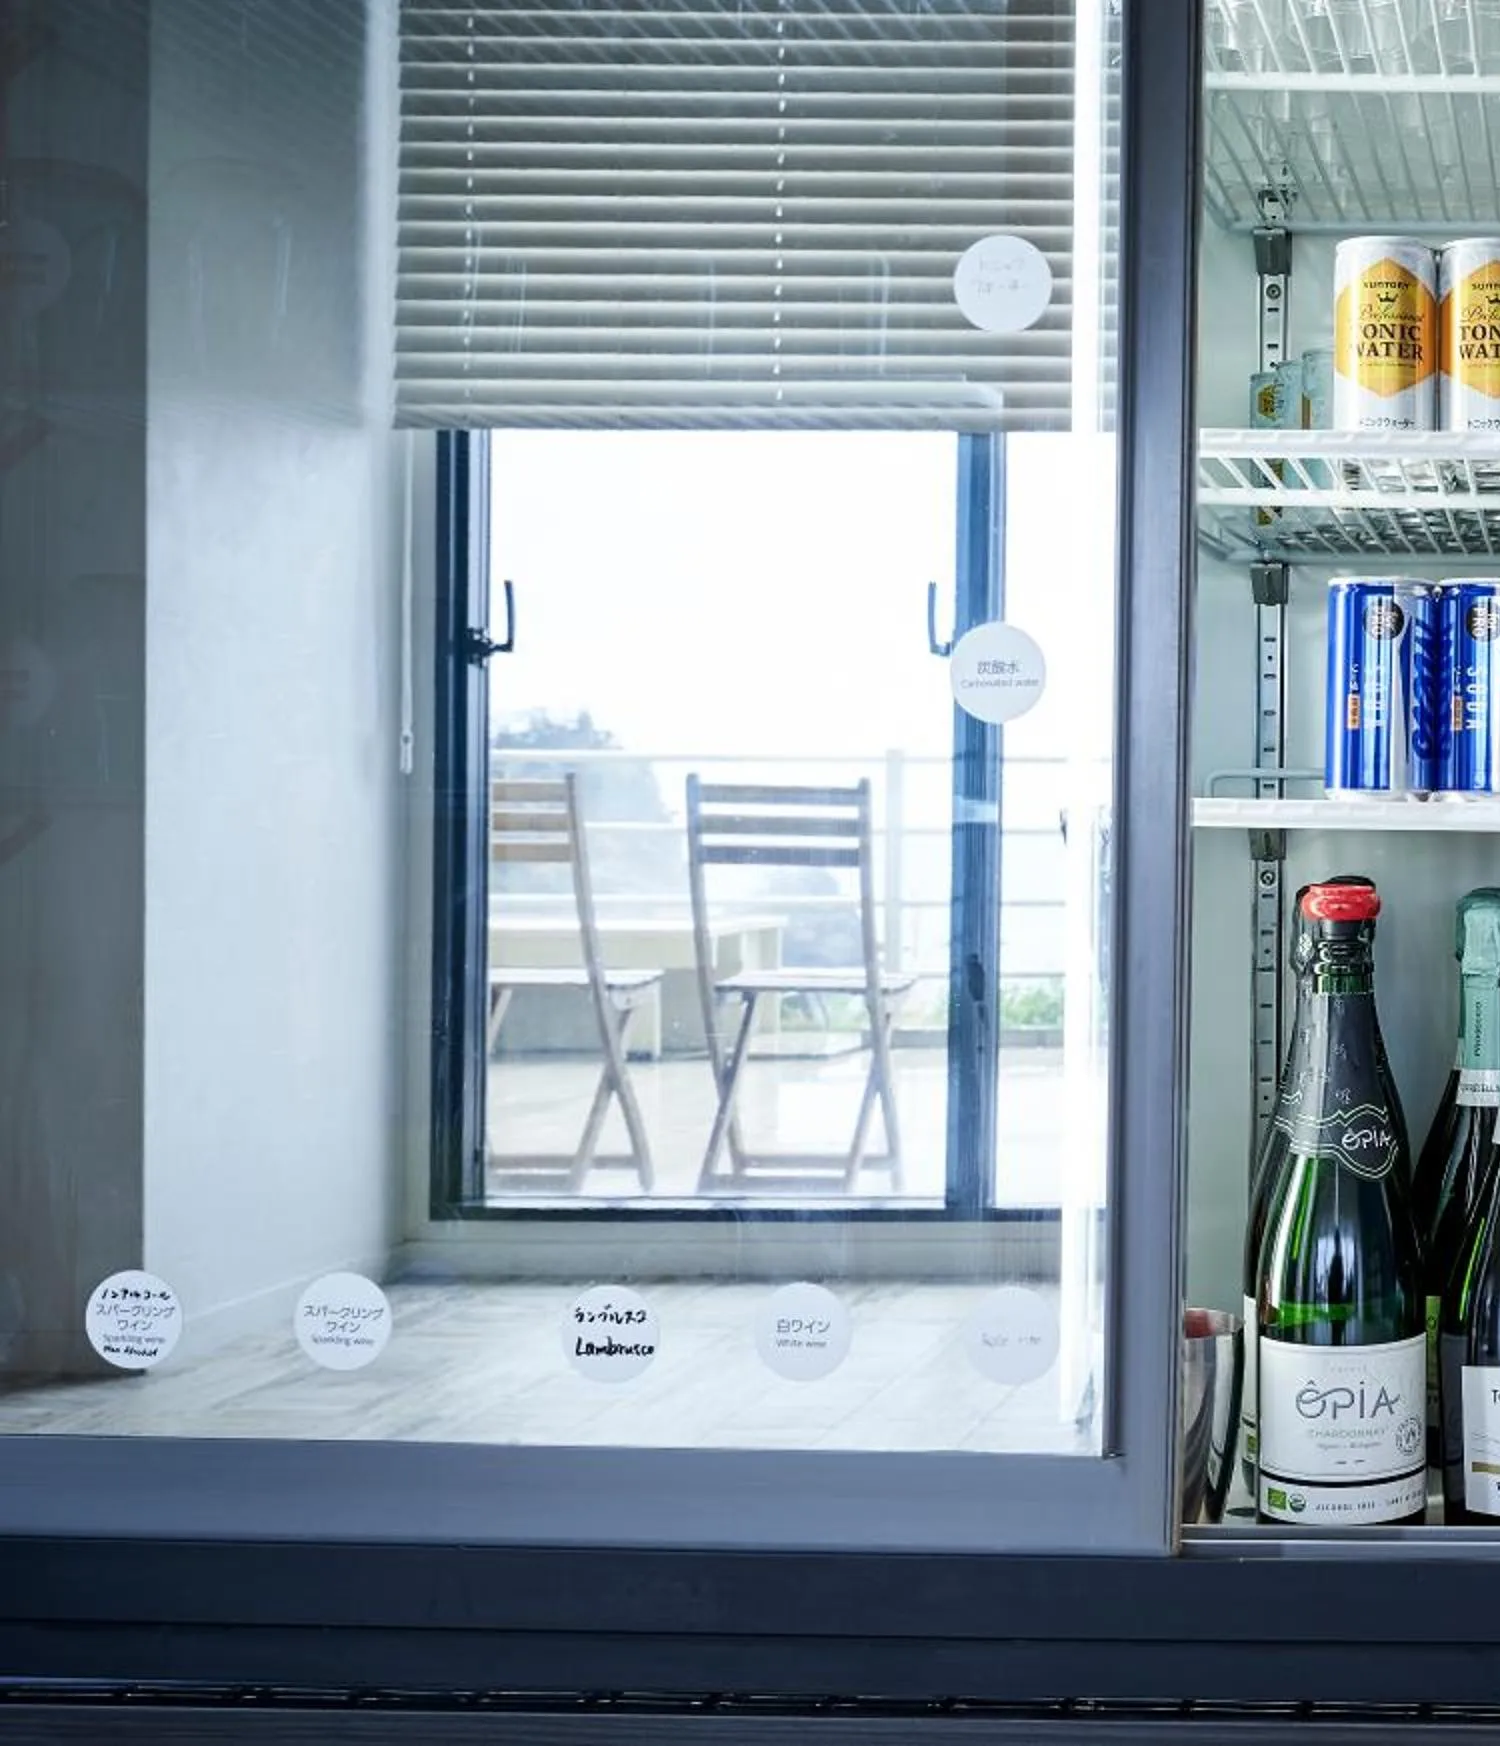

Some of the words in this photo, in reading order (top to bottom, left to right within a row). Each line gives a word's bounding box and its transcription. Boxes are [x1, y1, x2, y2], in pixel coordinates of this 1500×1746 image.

[1466, 666, 1486, 731] SODA
[117, 1319, 153, 1331] ワイン
[327, 1321, 361, 1333] ワイン
[777, 1318, 831, 1333] 白ワイン
[576, 1335, 655, 1356] Lambrusco
